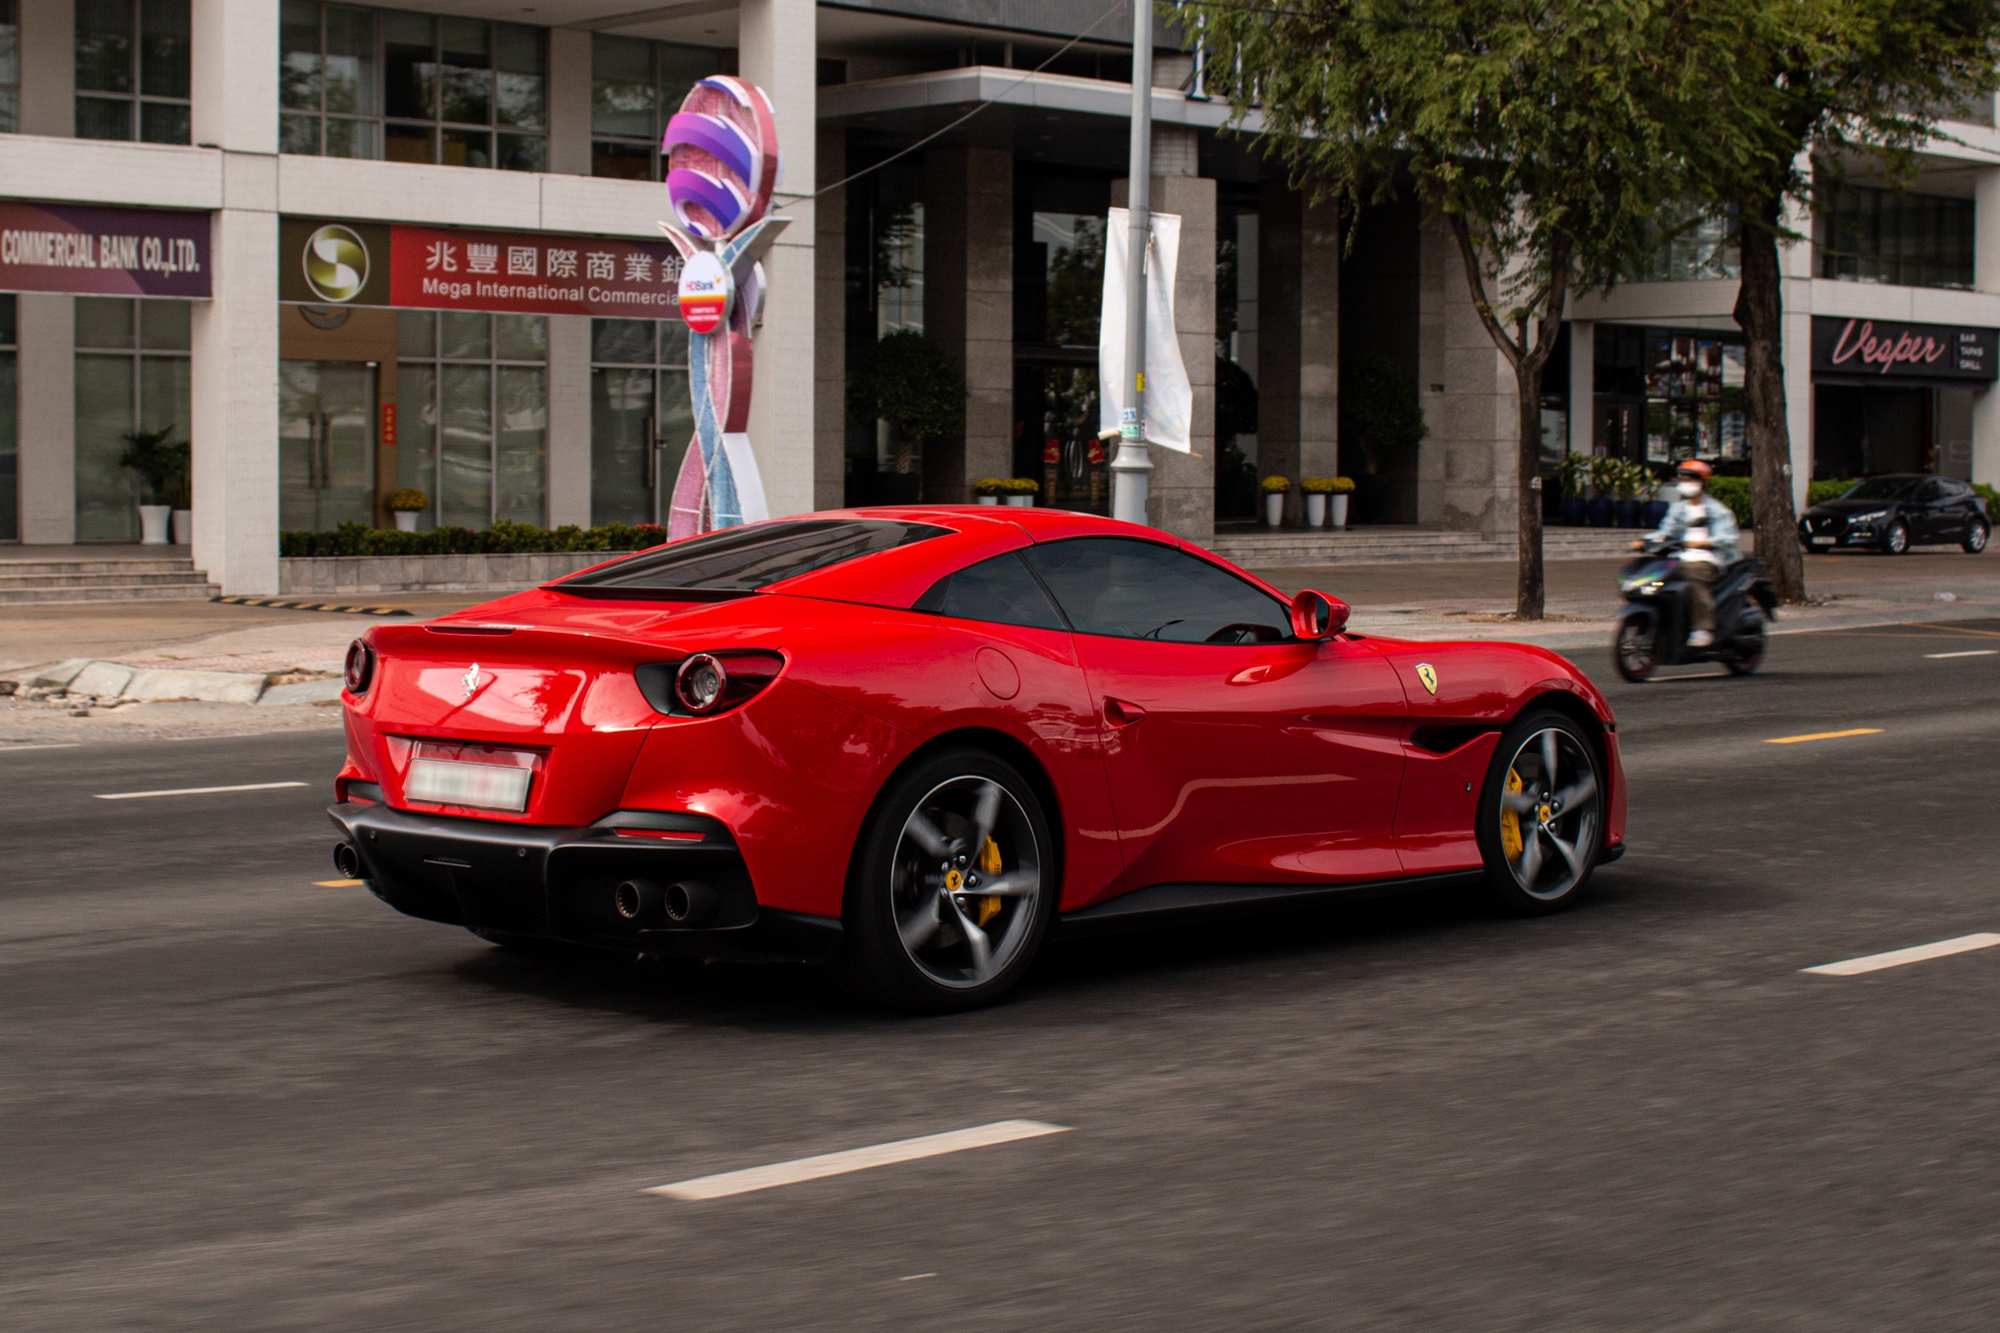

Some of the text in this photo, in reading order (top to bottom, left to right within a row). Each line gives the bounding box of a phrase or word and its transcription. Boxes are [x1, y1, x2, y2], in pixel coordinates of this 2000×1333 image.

[2, 230, 96, 268] COMMERCIAL
[100, 235, 139, 269] BANK
[423, 278, 679, 305] Mega International Commercia
[1832, 319, 1946, 374] Vesper
